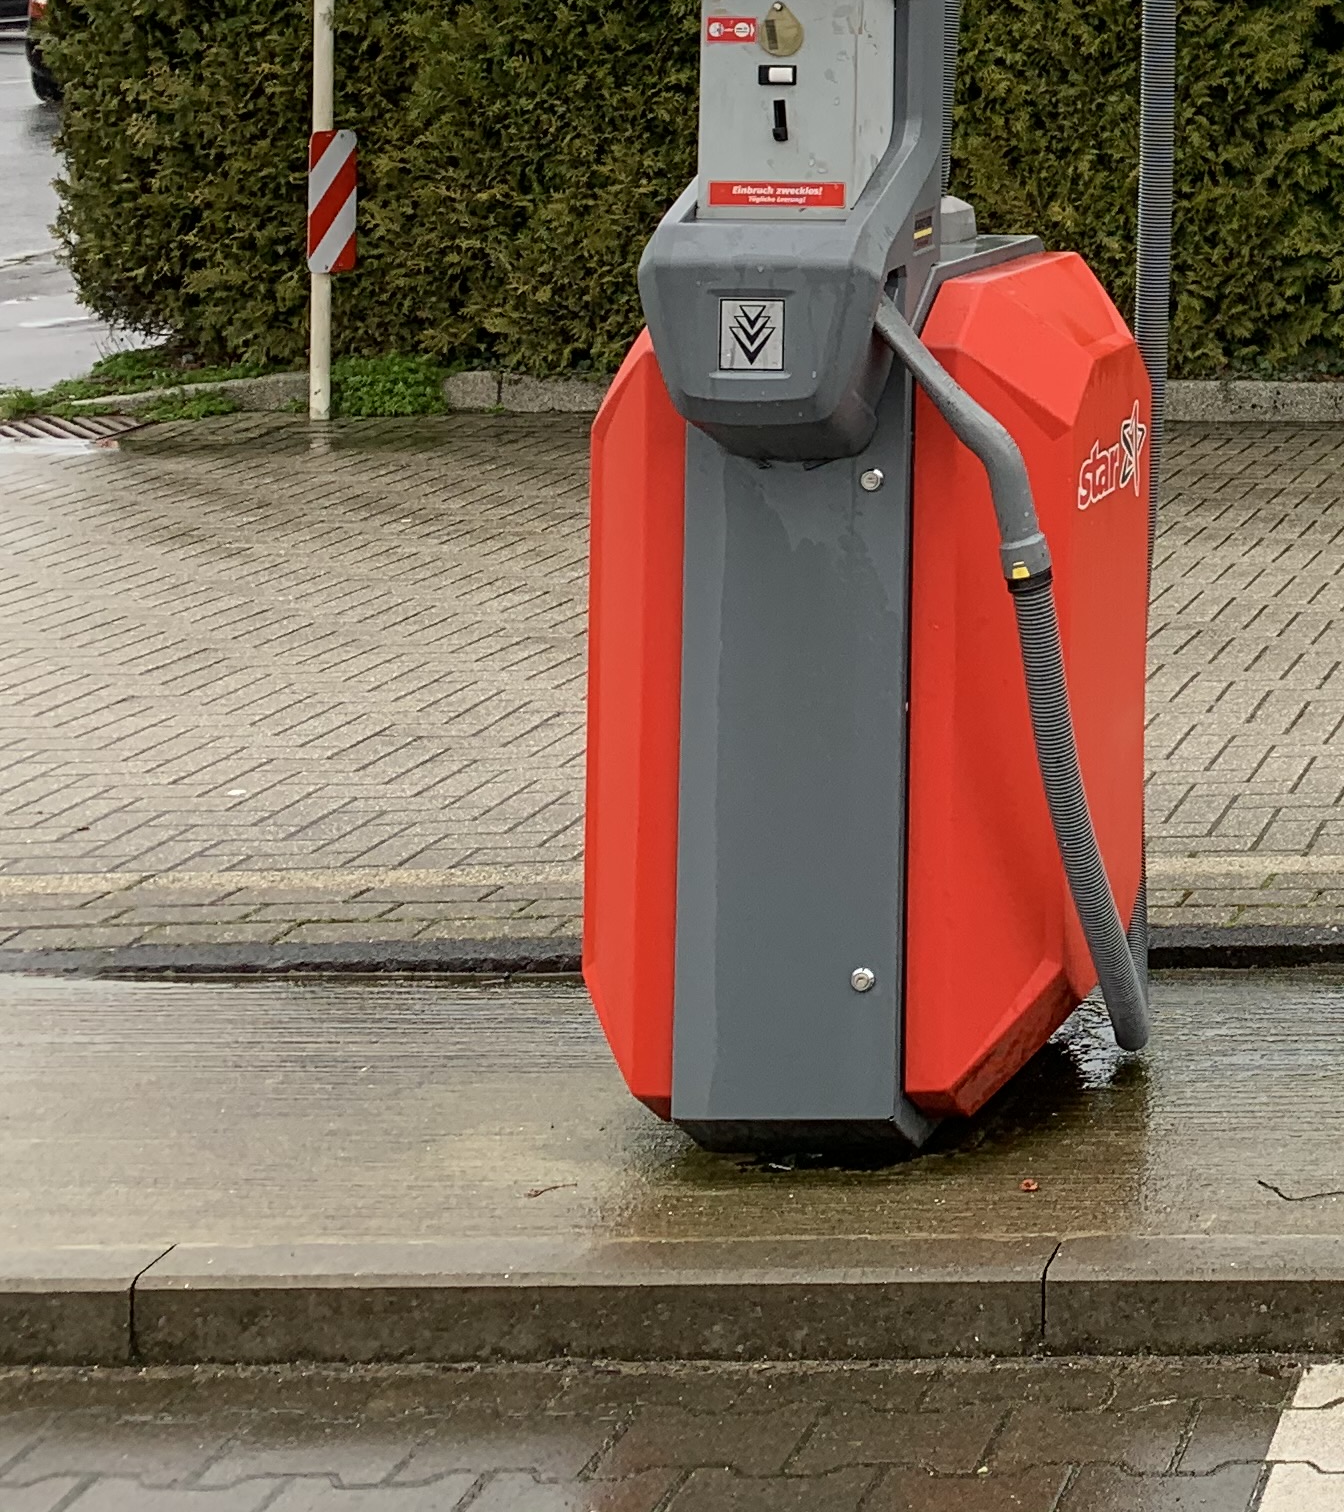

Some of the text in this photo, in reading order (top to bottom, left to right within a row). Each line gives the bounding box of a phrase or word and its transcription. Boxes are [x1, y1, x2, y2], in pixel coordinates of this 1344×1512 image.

[732, 185, 823, 196] Einbruch zwecklos!
[1077, 440, 1120, 511] star
